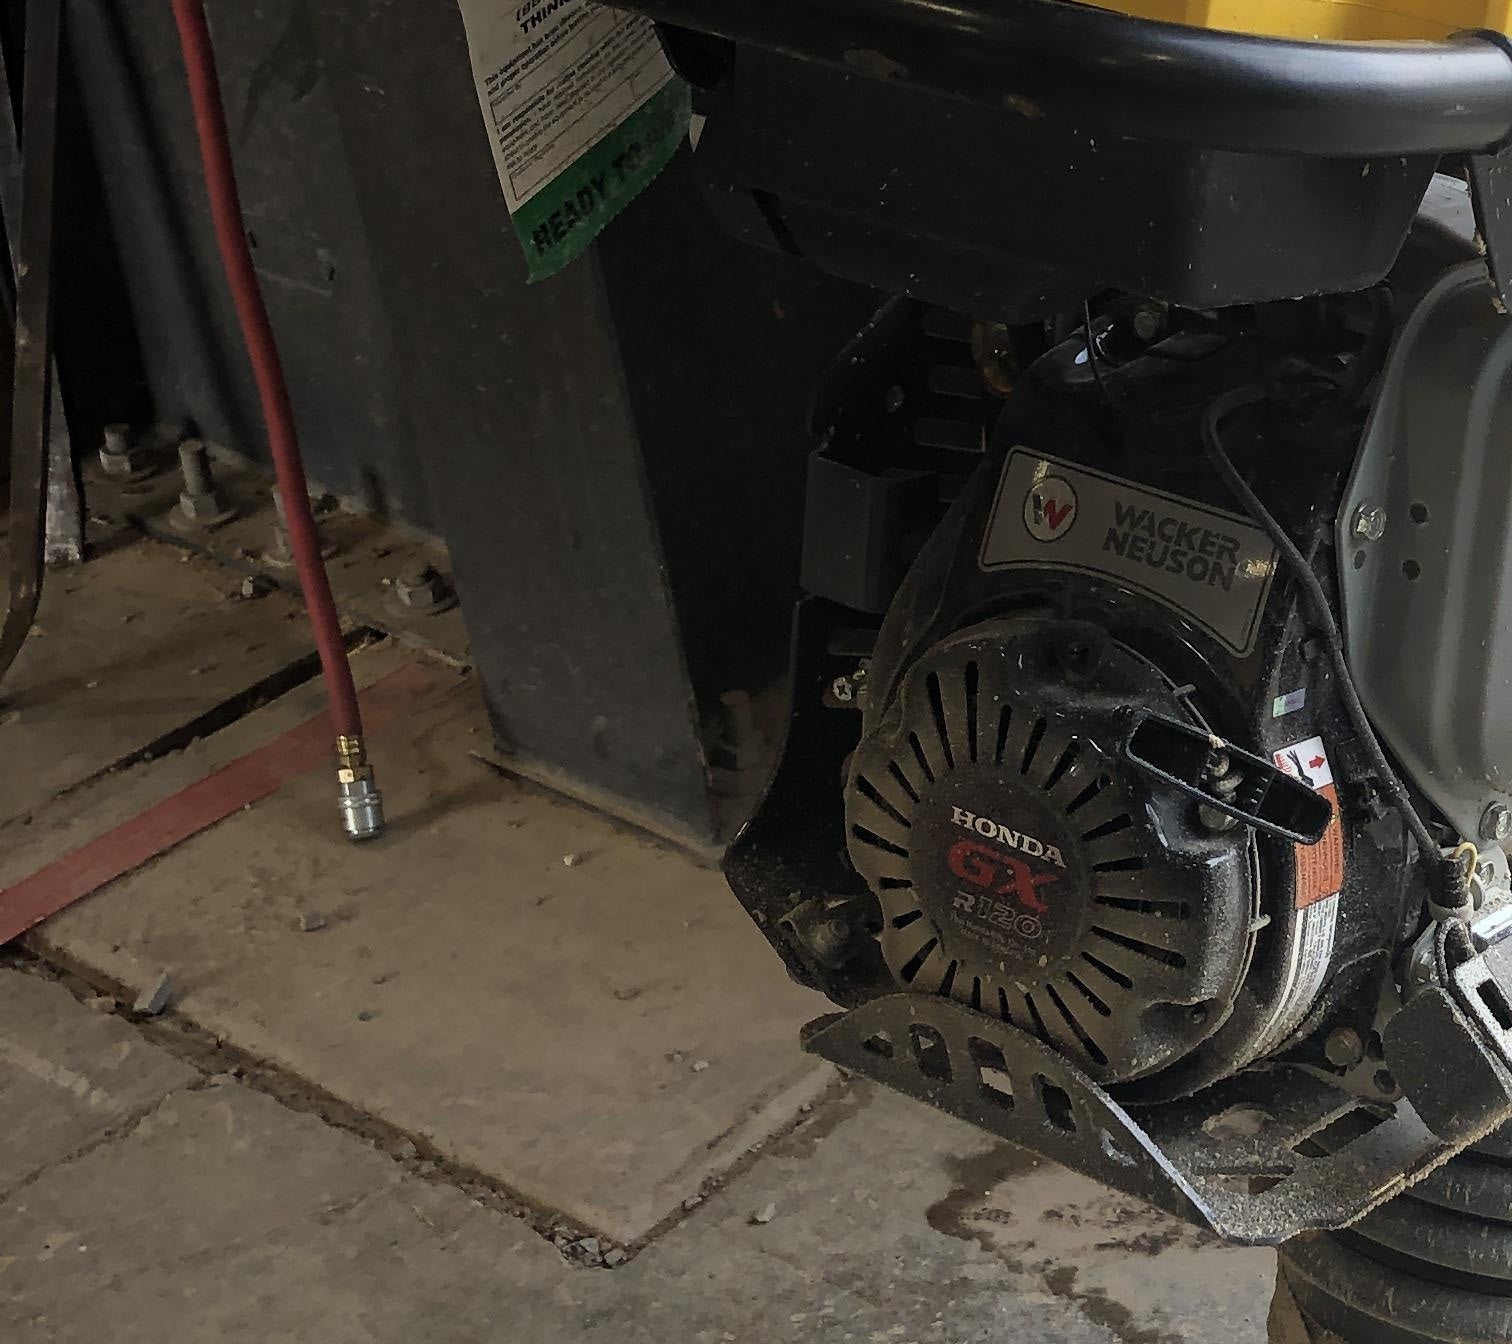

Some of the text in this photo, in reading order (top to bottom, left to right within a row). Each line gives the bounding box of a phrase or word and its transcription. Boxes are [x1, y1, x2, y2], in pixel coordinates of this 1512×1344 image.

[530, 170, 607, 256] READY
[1103, 528, 1236, 592] NEUSON
[1114, 500, 1241, 567] WACKER
[950, 805, 1068, 869] HONDA
[948, 838, 1059, 914] GX
